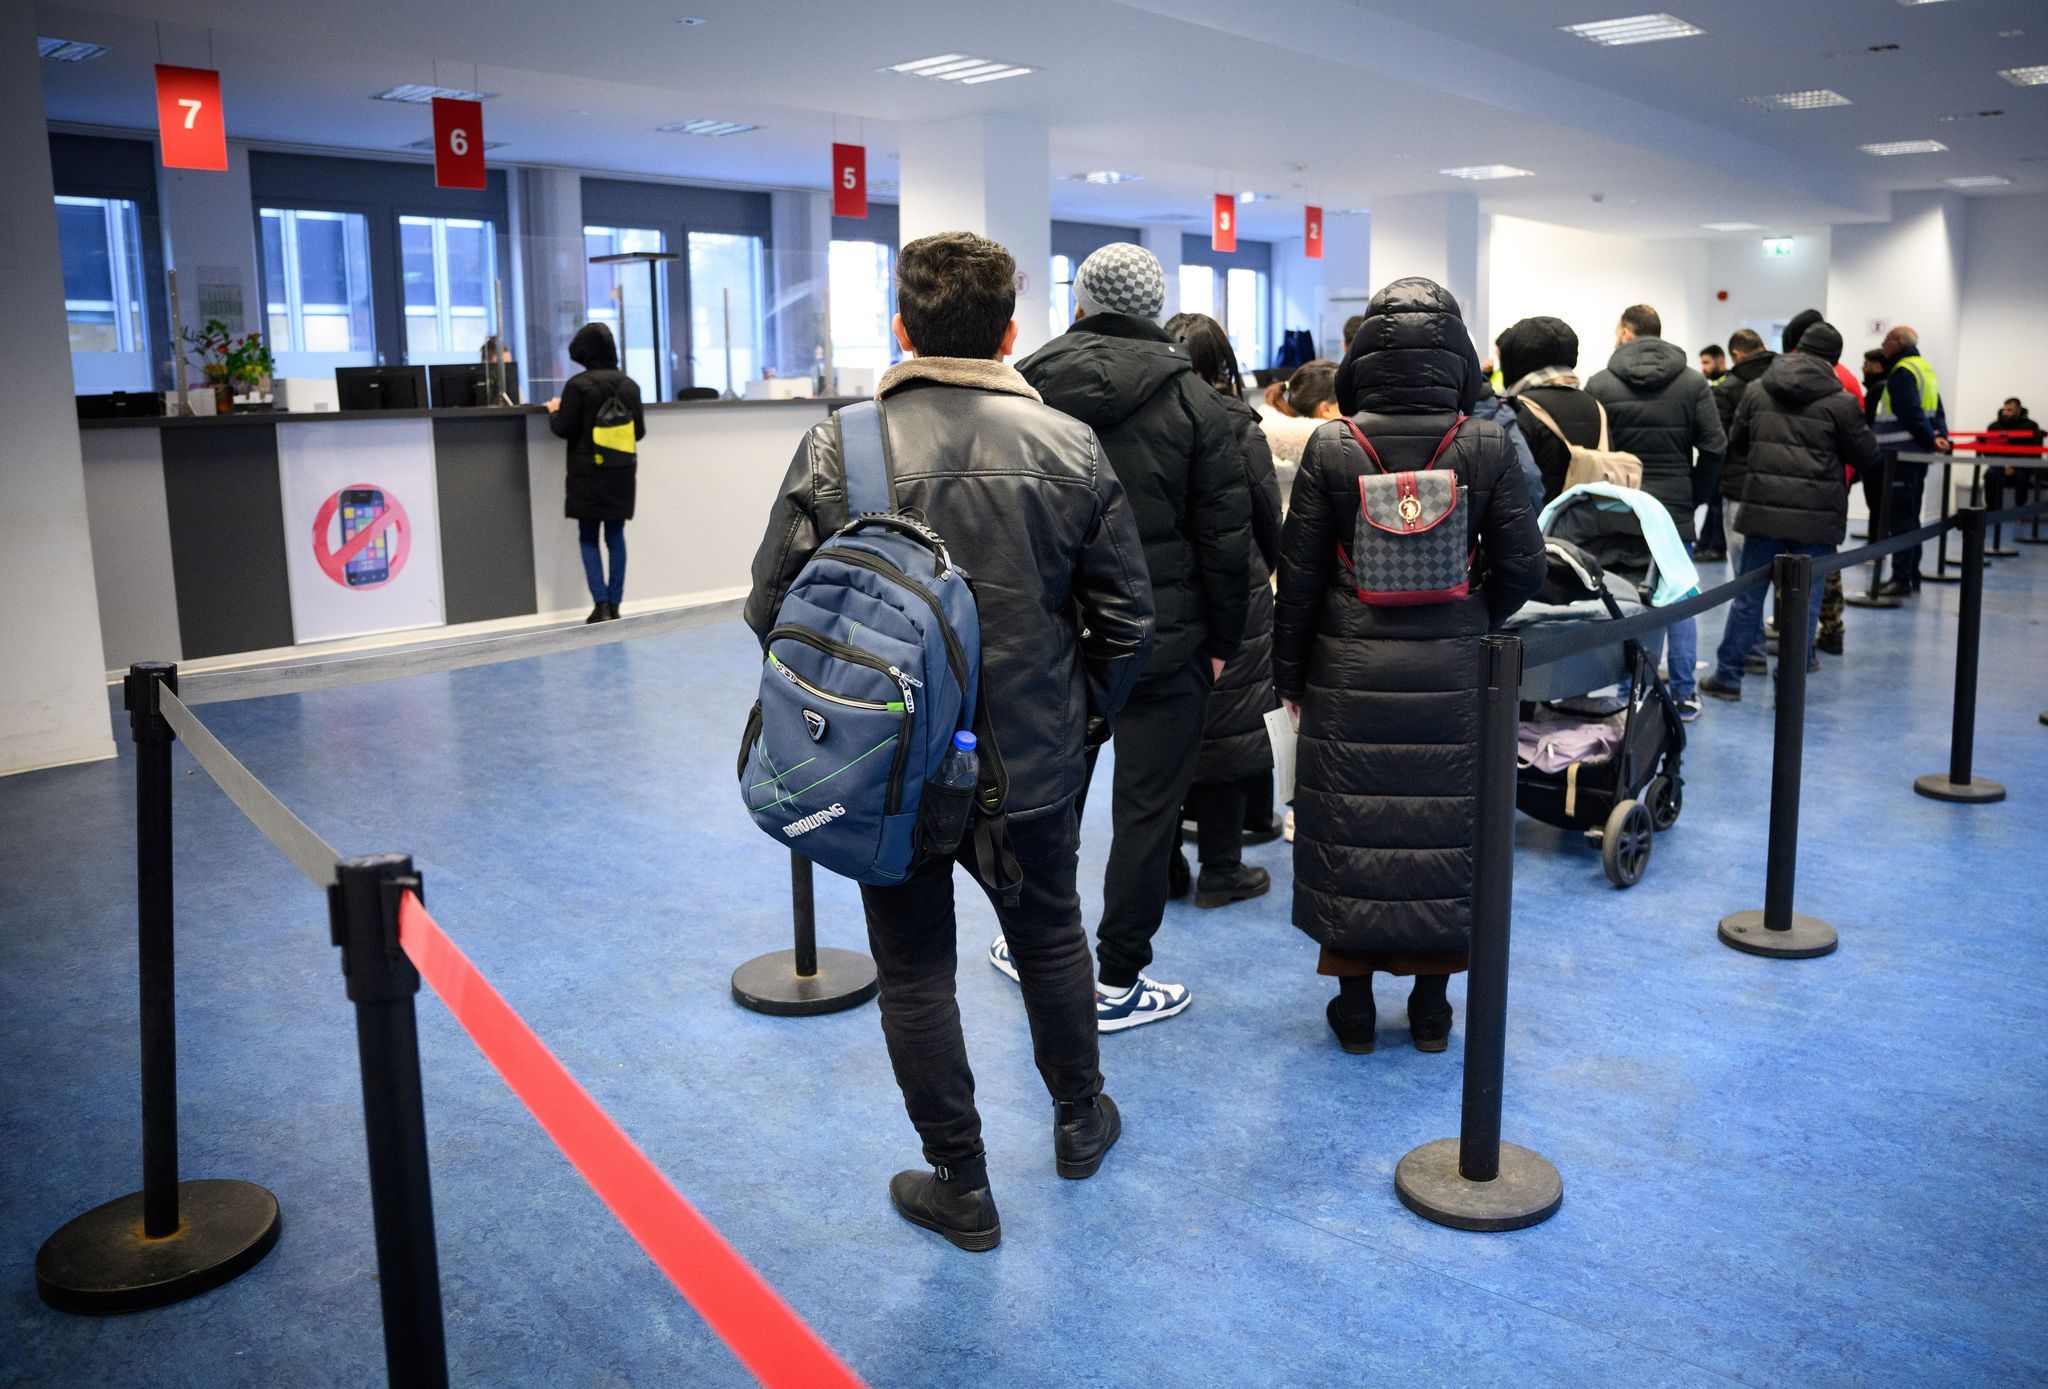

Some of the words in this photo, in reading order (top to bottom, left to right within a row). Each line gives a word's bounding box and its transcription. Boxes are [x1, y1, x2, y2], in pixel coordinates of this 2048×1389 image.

[178, 98, 202, 129] 7
[450, 128, 469, 156] 6
[843, 167, 856, 190] 5
[1220, 211, 1230, 231] 3
[1309, 222, 1319, 240] 2
[782, 802, 846, 838] BIAOWANG
